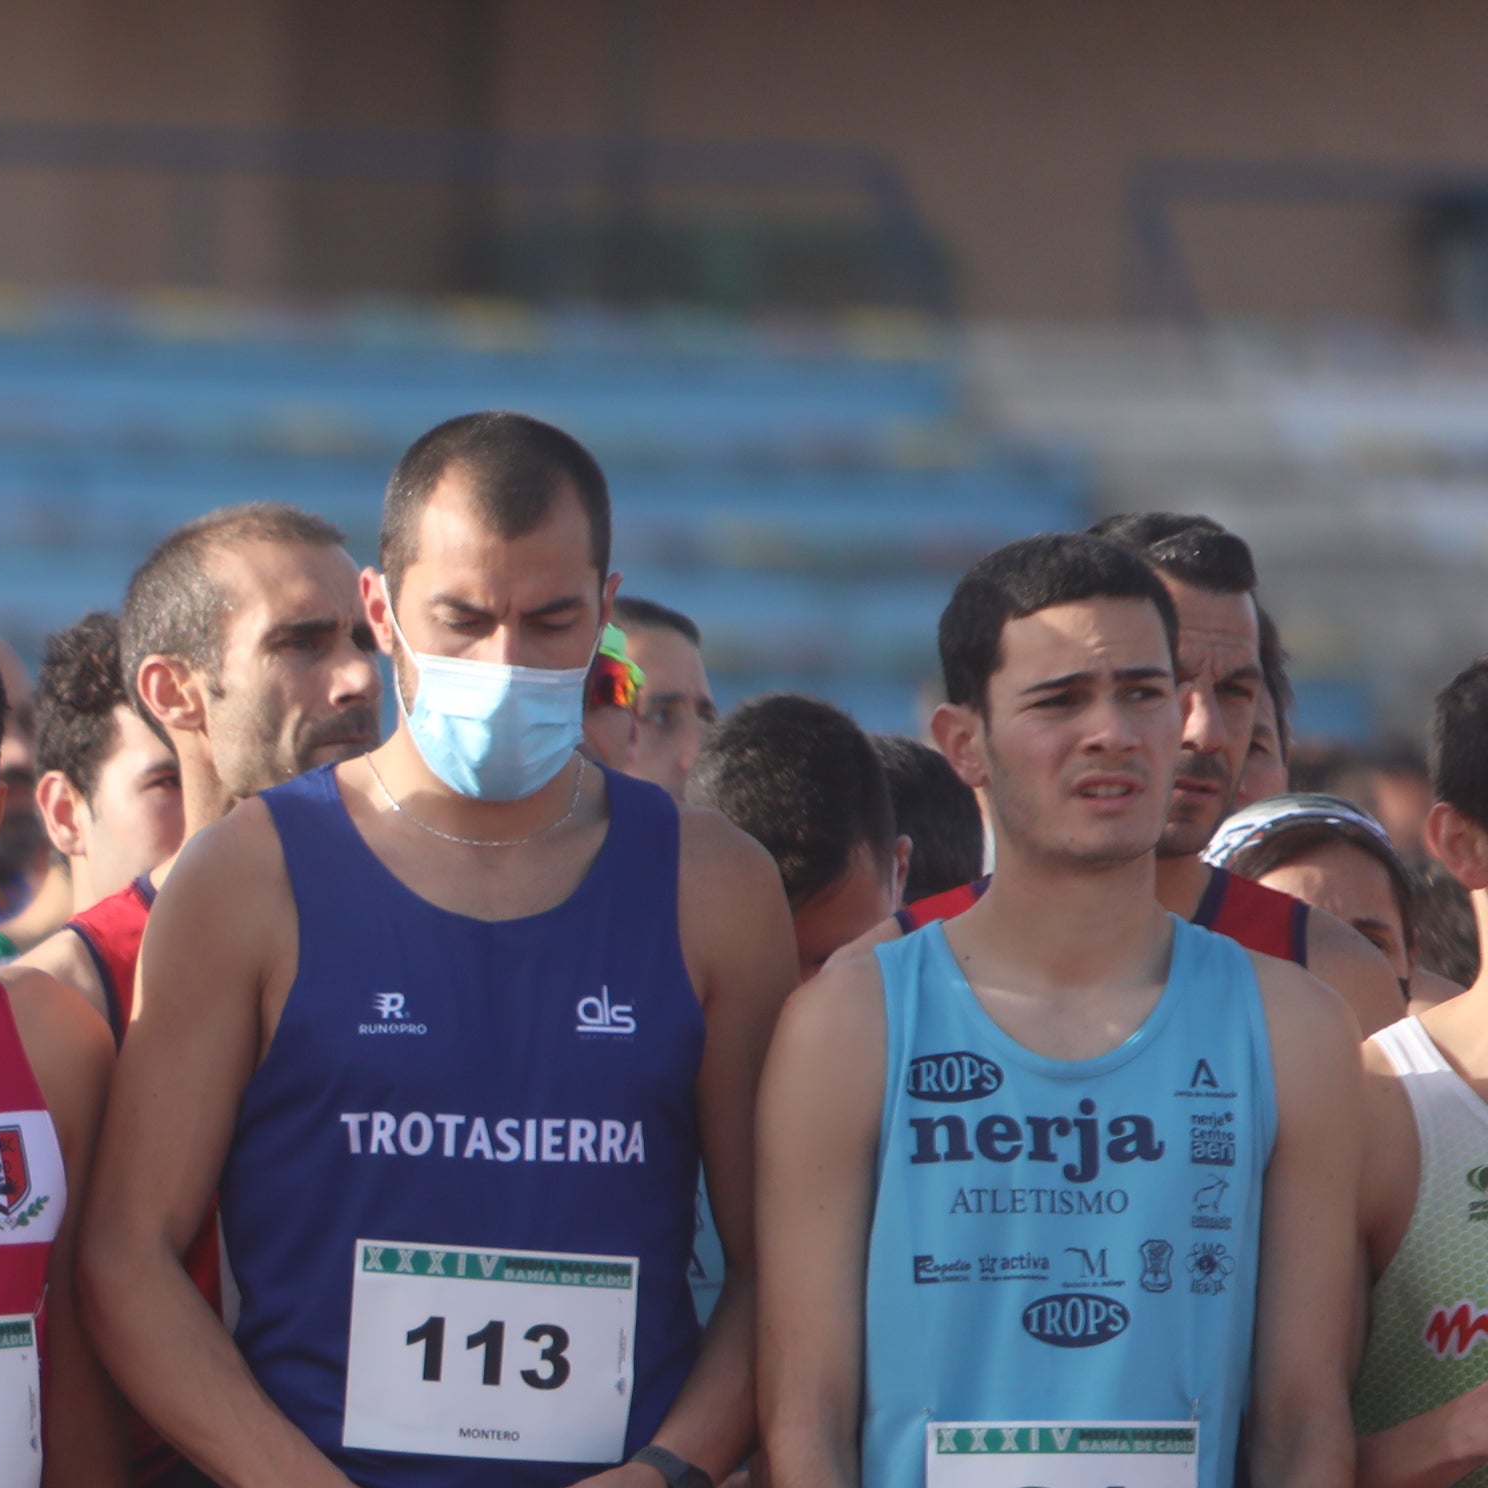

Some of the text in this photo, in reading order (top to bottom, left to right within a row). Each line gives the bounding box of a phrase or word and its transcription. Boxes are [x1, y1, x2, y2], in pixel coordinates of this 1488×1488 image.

[907, 1056, 1000, 1094] TROPS
[340, 1110, 646, 1164] TROTASIERRA
[909, 1097, 1166, 1184] nerja
[949, 1186, 1130, 1216] ATLETISMO
[1027, 1297, 1125, 1337] TROPS
[405, 1315, 571, 1391] 113
[458, 1427, 521, 1442] MONTERO
